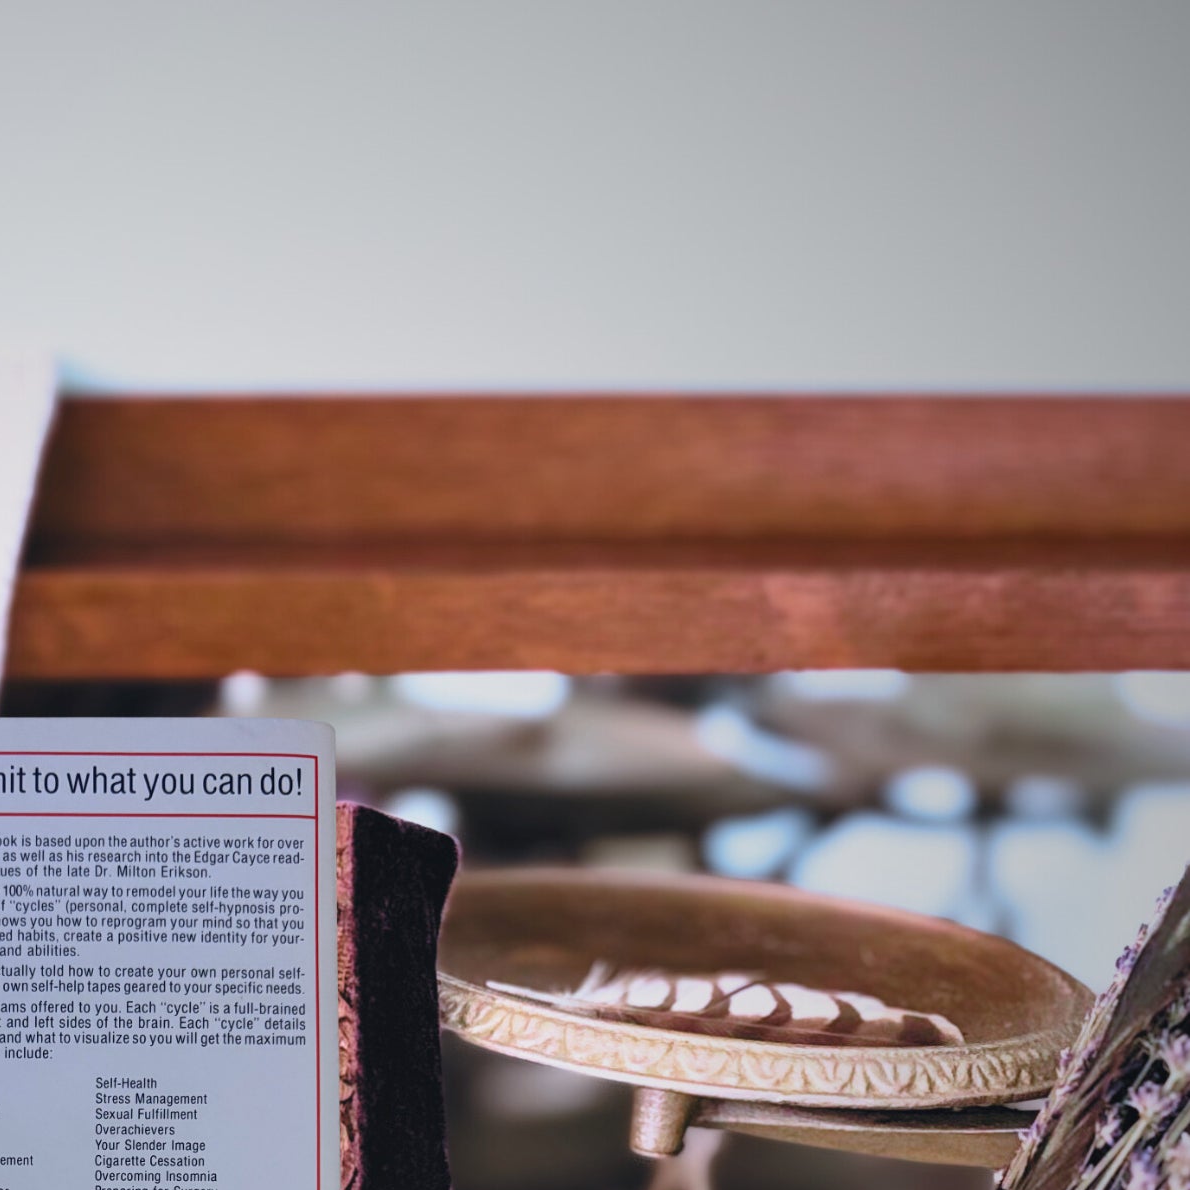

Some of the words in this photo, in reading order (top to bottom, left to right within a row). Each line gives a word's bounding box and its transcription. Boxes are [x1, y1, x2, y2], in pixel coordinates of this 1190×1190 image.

[32, 766, 59, 794] to
[66, 765, 137, 794] what
[143, 773, 195, 801] you
[202, 773, 252, 795] can
[260, 766, 302, 796] do!
[17, 929, 59, 944] habits,
[63, 930, 102, 942] create
[106, 932, 114, 942] a
[118, 930, 168, 945] positive
[171, 933, 197, 943] new
[201, 930, 248, 946] identity
[250, 931, 269, 943] for
[271, 934, 305, 947] your-
[2, 982, 29, 992] own
[31, 980, 85, 995] self-help
[87, 981, 121, 996] tapes
[123, 981, 166, 996] geared
[169, 982, 181, 993] to
[183, 984, 213, 997] your
[215, 981, 264, 997] specific
[266, 982, 305, 994] needs.
[95, 1076, 157, 1089] Self-Health
[95, 1092, 131, 1104] Stress
[135, 1092, 208, 1107] Management
[95, 1107, 133, 1120] Sexual
[137, 1107, 198, 1120] Fulfillment
[95, 1123, 175, 1135] Overachievers
[95, 1138, 121, 1150] Your
[124, 1138, 167, 1151] Slender
[171, 1139, 206, 1154] Image
[94, 1154, 146, 1169] Cigarette
[149, 1154, 205, 1167] Cessation
[94, 1169, 161, 1184] Overcoming
[166, 1169, 217, 1182] Insomnia
